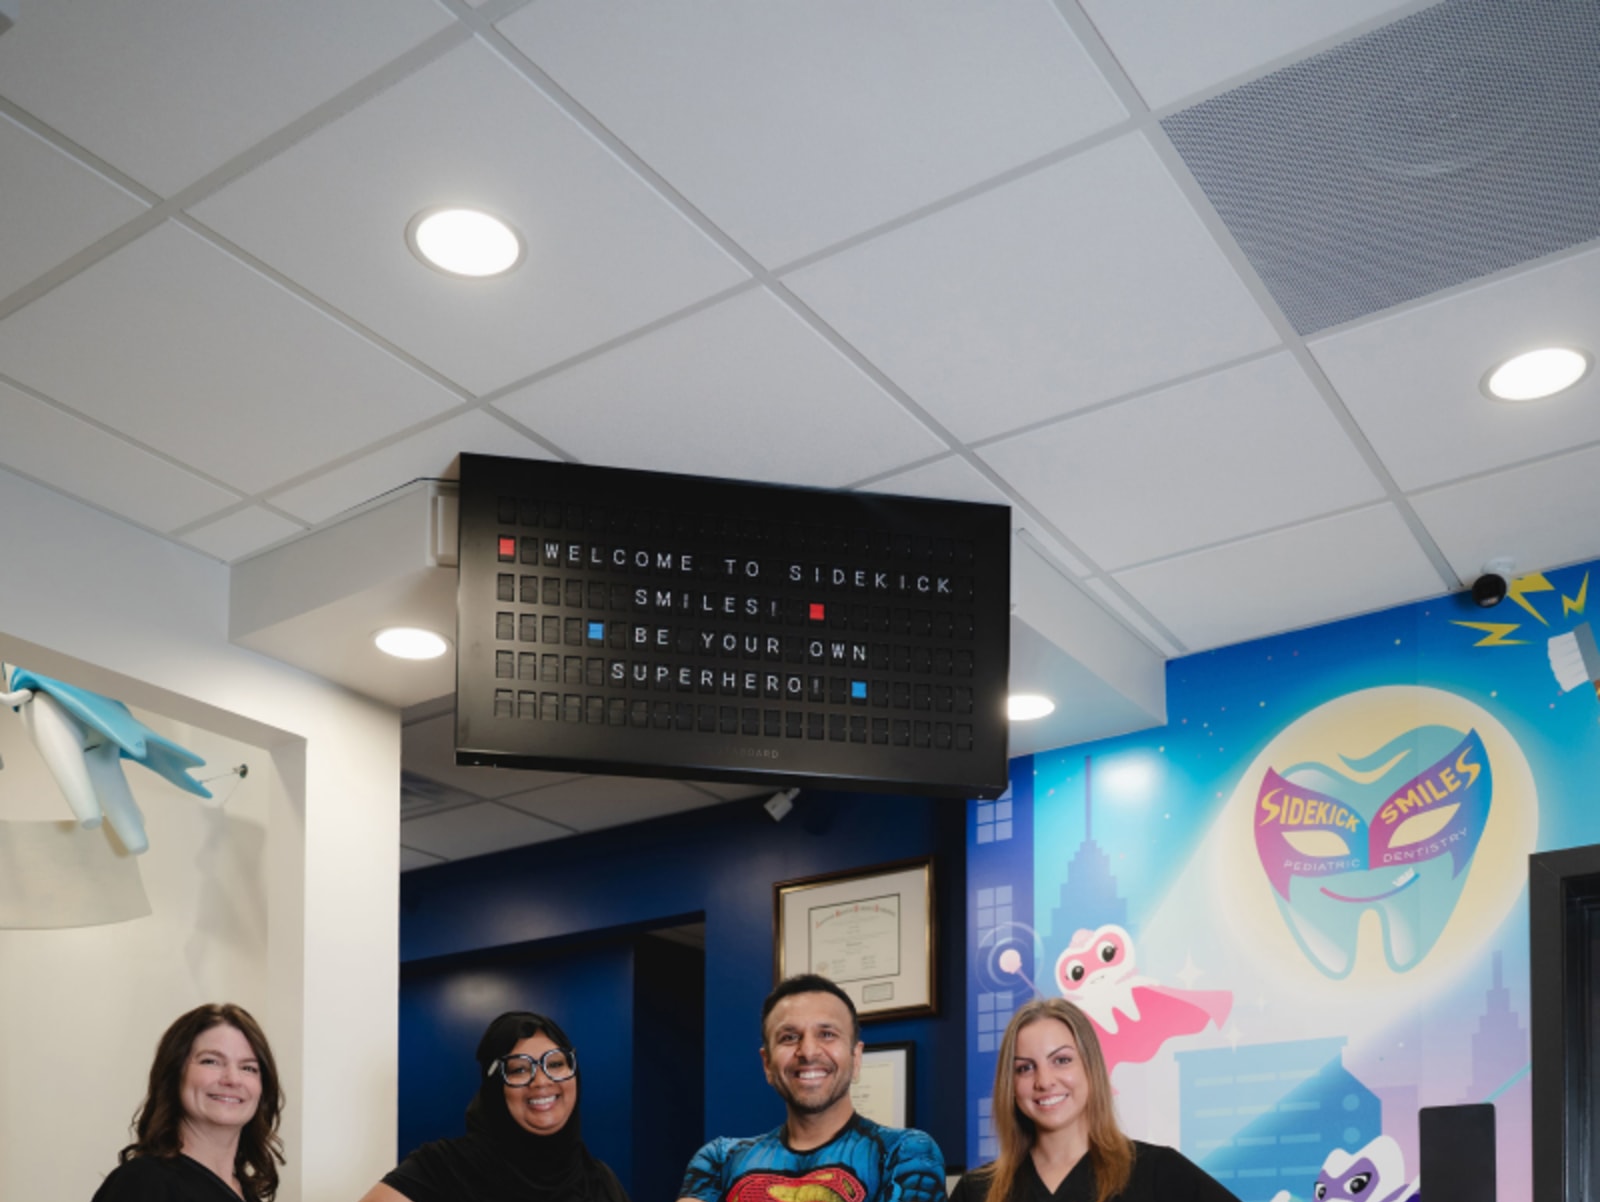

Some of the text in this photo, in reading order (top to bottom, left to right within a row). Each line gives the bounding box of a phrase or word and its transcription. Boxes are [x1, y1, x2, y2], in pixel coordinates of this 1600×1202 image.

[545, 543, 950, 593] WELCOME TO SIDEKICK
[635, 589, 776, 616] SMILES!
[635, 627, 865, 661] BE YOUR OWN
[611, 663, 819, 695] SUPERHERO!
[1259, 745, 1481, 833] SIDEKICK SMILES
[1283, 827, 1468, 872] PEDIATRIC DENTISTRY
